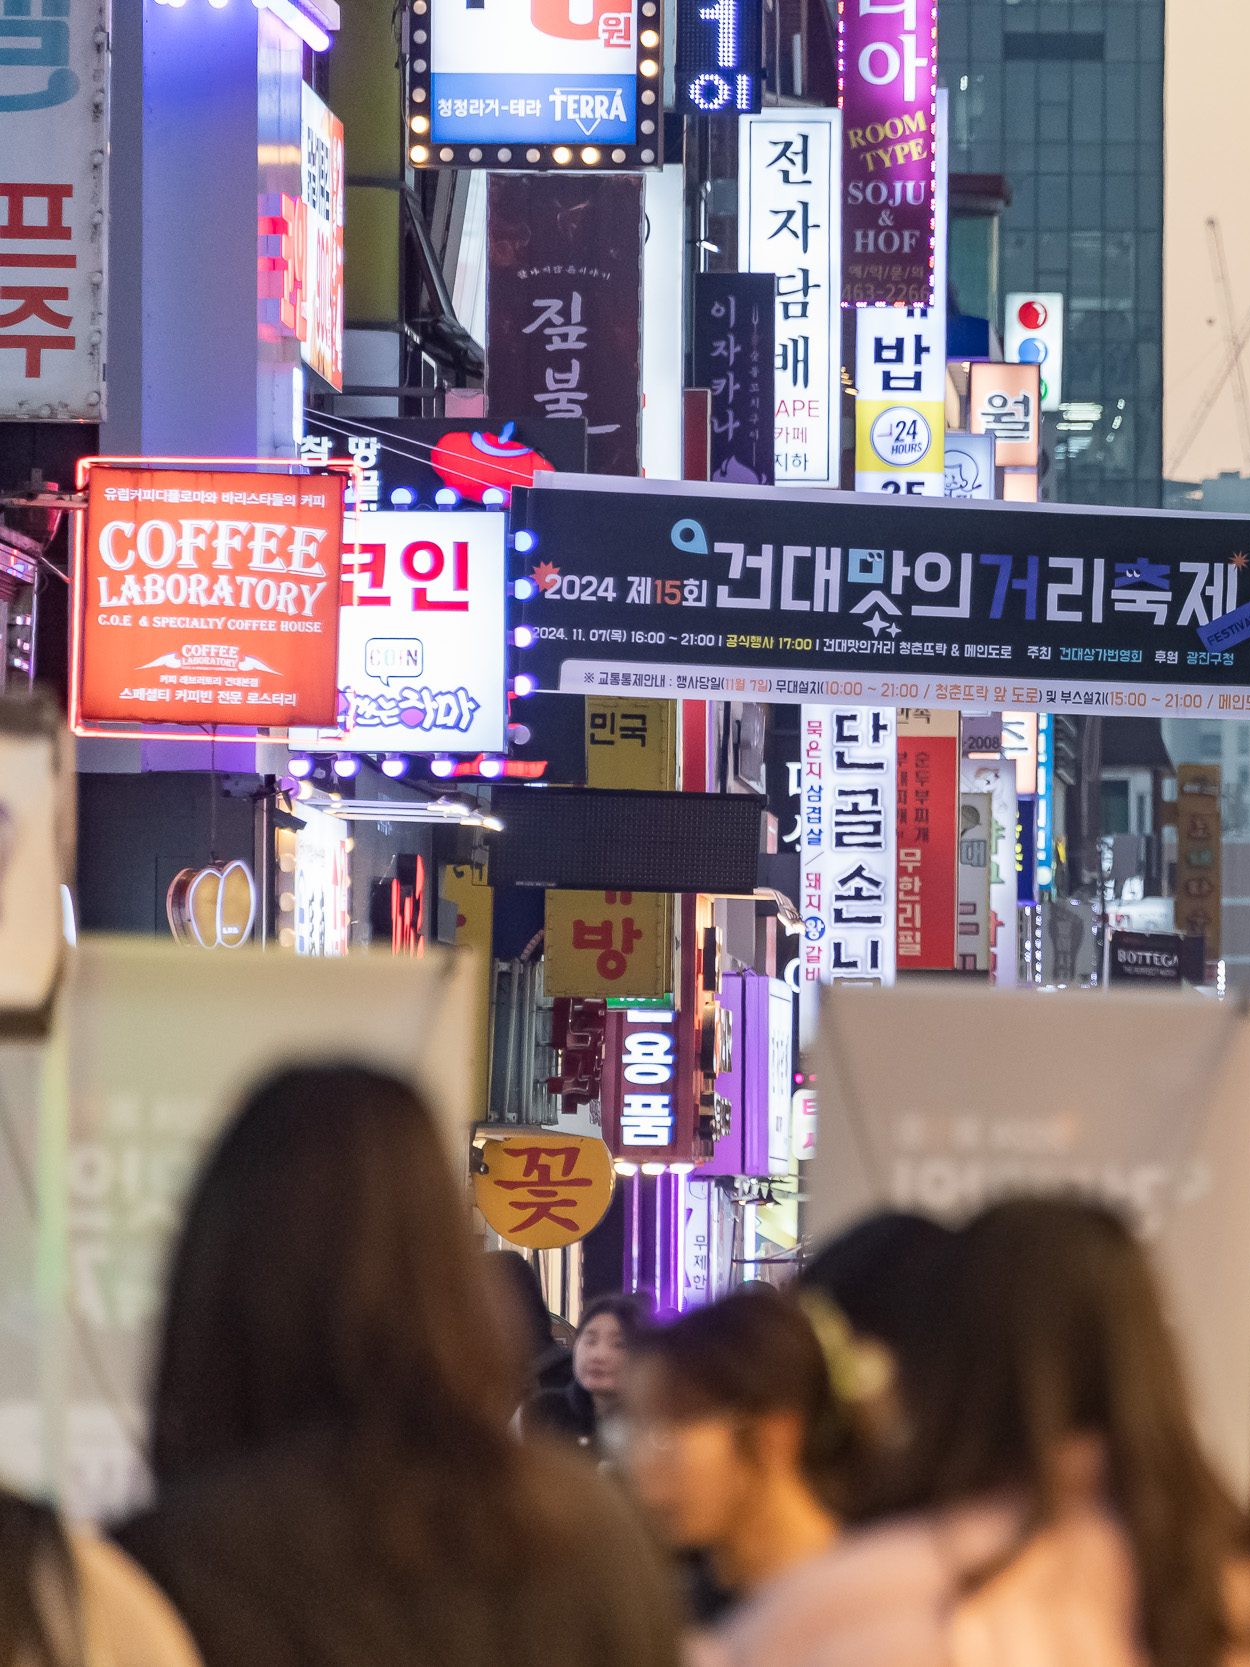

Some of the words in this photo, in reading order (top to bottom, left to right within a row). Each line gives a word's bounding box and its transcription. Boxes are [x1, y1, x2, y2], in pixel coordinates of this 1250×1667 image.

[437, 98, 542, 118] 청정라거-테라
[549, 88, 628, 123] TERRA
[848, 110, 927, 150] ROOM
[859, 138, 928, 172] TYPE
[848, 180, 925, 207] SOJU
[878, 209, 895, 227] &
[854, 229, 921, 254] HOF
[766, 133, 821, 389] 전자담배
[893, 419, 918, 442] 24
[891, 442, 922, 456] HOURS
[104, 488, 218, 506] 유럽커피디플로마와
[222, 491, 296, 508] 바리스타들의
[300, 495, 325, 508] 커피
[99, 519, 327, 578] COFFEE
[97, 572, 327, 617] LABORATORY
[545, 575, 617, 602] 2024
[626, 576, 707, 608] 제15회
[98, 614, 133, 628] C.O.E
[139, 616, 149, 628] &
[152, 616, 224, 632] SPECIALTY
[227, 619, 277, 632] COFFEE
[280, 620, 322, 634] HOUSE
[181, 645, 240, 659] COFFEE
[181, 657, 240, 668] LABORATORY
[370, 649, 418, 667] COIN
[590, 629, 627, 643] 07(목)
[631, 631, 665, 645] 16:00
[681, 633, 715, 647] 21:00
[726, 634, 774, 649] 공식행사
[778, 637, 812, 651] 17:00
[823, 638, 895, 655] 건대맛의거리
[899, 641, 948, 657] 청춘뜨락
[964, 643, 1012, 660] 메인도로
[1027, 645, 1051, 660] 주최
[1059, 647, 1143, 663] 건대상가번영회
[1154, 650, 1179, 665] 후원
[1186, 651, 1235, 666] 광진구청
[160, 675, 177, 685] 커피
[598, 671, 666, 688] 교통통제안내
[880, 683, 919, 698] 21:00
[935, 683, 989, 702] 청춘뜨락
[993, 685, 1007, 703] 앞
[1012, 686, 1042, 704] 도로)
[1046, 689, 1057, 705] 및
[1164, 693, 1203, 709] 21:00
[119, 688, 169, 702] 스페셜티
[175, 688, 213, 704] 커피빈
[217, 690, 242, 704] 전문
[246, 691, 297, 707] 로스터리
[589, 711, 648, 748] 민국
[805, 720, 823, 779] 묵은지
[806, 784, 823, 846] 삼겹살
[832, 711, 889, 986] 단골손님
[898, 848, 923, 956] 무한리필
[620, 1009, 675, 1146] 용품
[494, 1146, 593, 1234] 꽃
